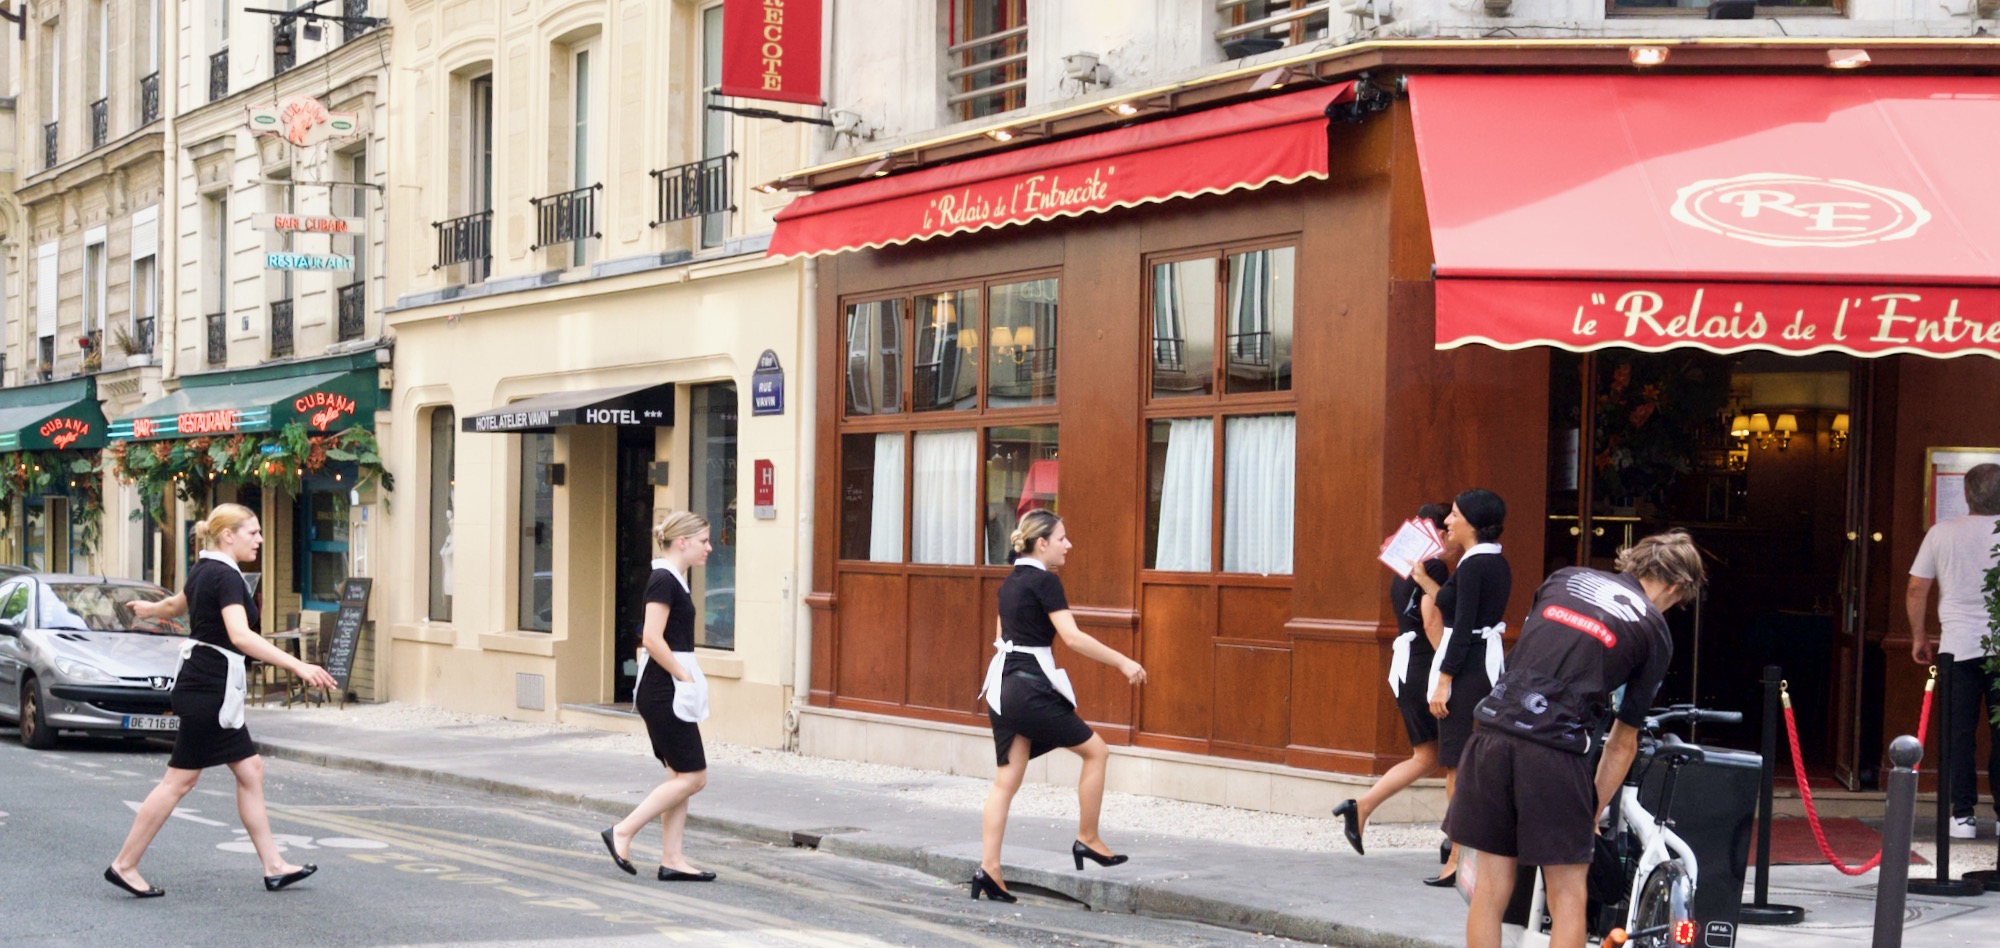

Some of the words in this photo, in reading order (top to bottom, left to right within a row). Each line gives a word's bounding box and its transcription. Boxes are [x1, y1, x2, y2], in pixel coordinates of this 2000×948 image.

[923, 209, 933, 230] le
[993, 196, 1006, 217] de
[275, 216, 299, 230] BAR
[1572, 305, 1597, 335] le
[1782, 309, 1817, 340] de
[759, 382, 772, 393] RUE
[295, 392, 356, 415] CUBANA
[755, 396, 776, 407] VAVIN
[133, 418, 151, 438] BAR
[177, 409, 235, 433] RESTAURANT
[476, 415, 499, 431] HOTEL
[499, 412, 527, 428] ATELIER
[528, 410, 549, 426] VAVIN
[586, 409, 641, 424] HOTEL
[40, 418, 90, 437] CUBANA
[762, 467, 772, 485] H
